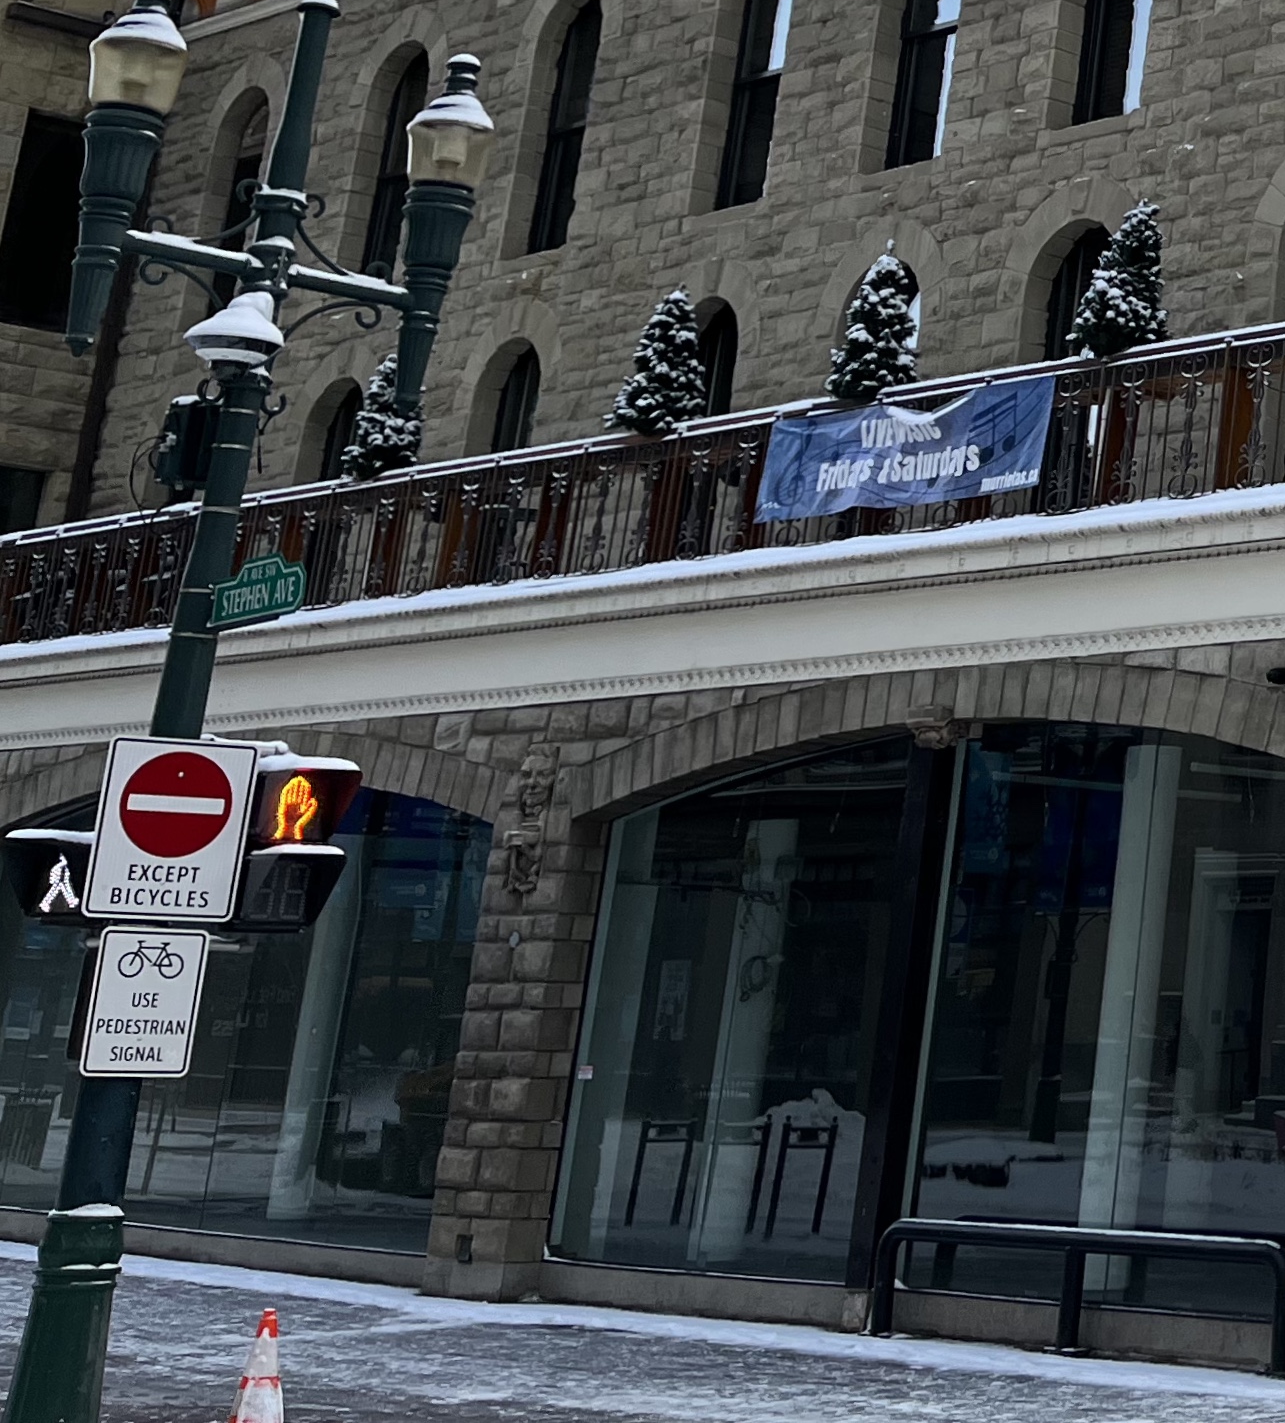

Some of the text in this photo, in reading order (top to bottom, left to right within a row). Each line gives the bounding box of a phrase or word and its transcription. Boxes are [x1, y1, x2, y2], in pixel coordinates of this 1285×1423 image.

[861, 418, 893, 449] LIVE
[816, 457, 874, 492] Fridays
[891, 444, 980, 483] Saturdays
[221, 576, 296, 617] STEPHEN AVE
[127, 863, 201, 884] EXCEPT
[109, 887, 210, 908] BICYCLES
[131, 992, 160, 1009] USE
[95, 1018, 187, 1035] PEDESTRIAN
[109, 1045, 164, 1063] SIGNAL
